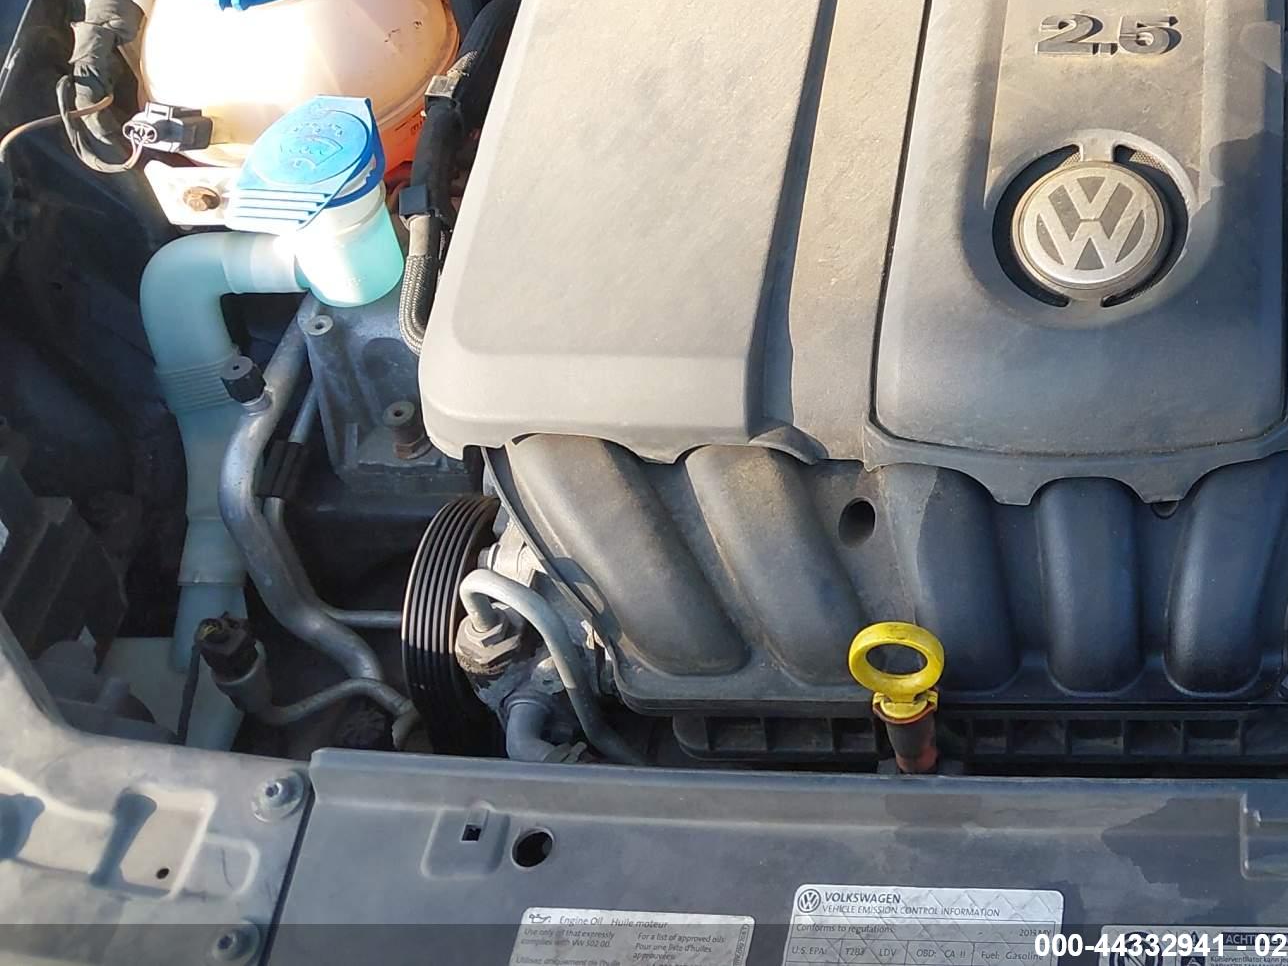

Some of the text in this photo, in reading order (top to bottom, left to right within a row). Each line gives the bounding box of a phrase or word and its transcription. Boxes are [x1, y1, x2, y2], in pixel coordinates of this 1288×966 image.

[1035, 14, 1182, 55] 2.5
[824, 892, 901, 905] VOLKSWAGEN
[821, 904, 1000, 917] VEHICLE EMISSION CONTROL INFORMATION
[560, 916, 668, 929] Engine Oil Huile moteur
[796, 924, 834, 932] Conforms
[879, 948, 897, 957] LDV
[1005, 951, 1044, 960] Gasoline
